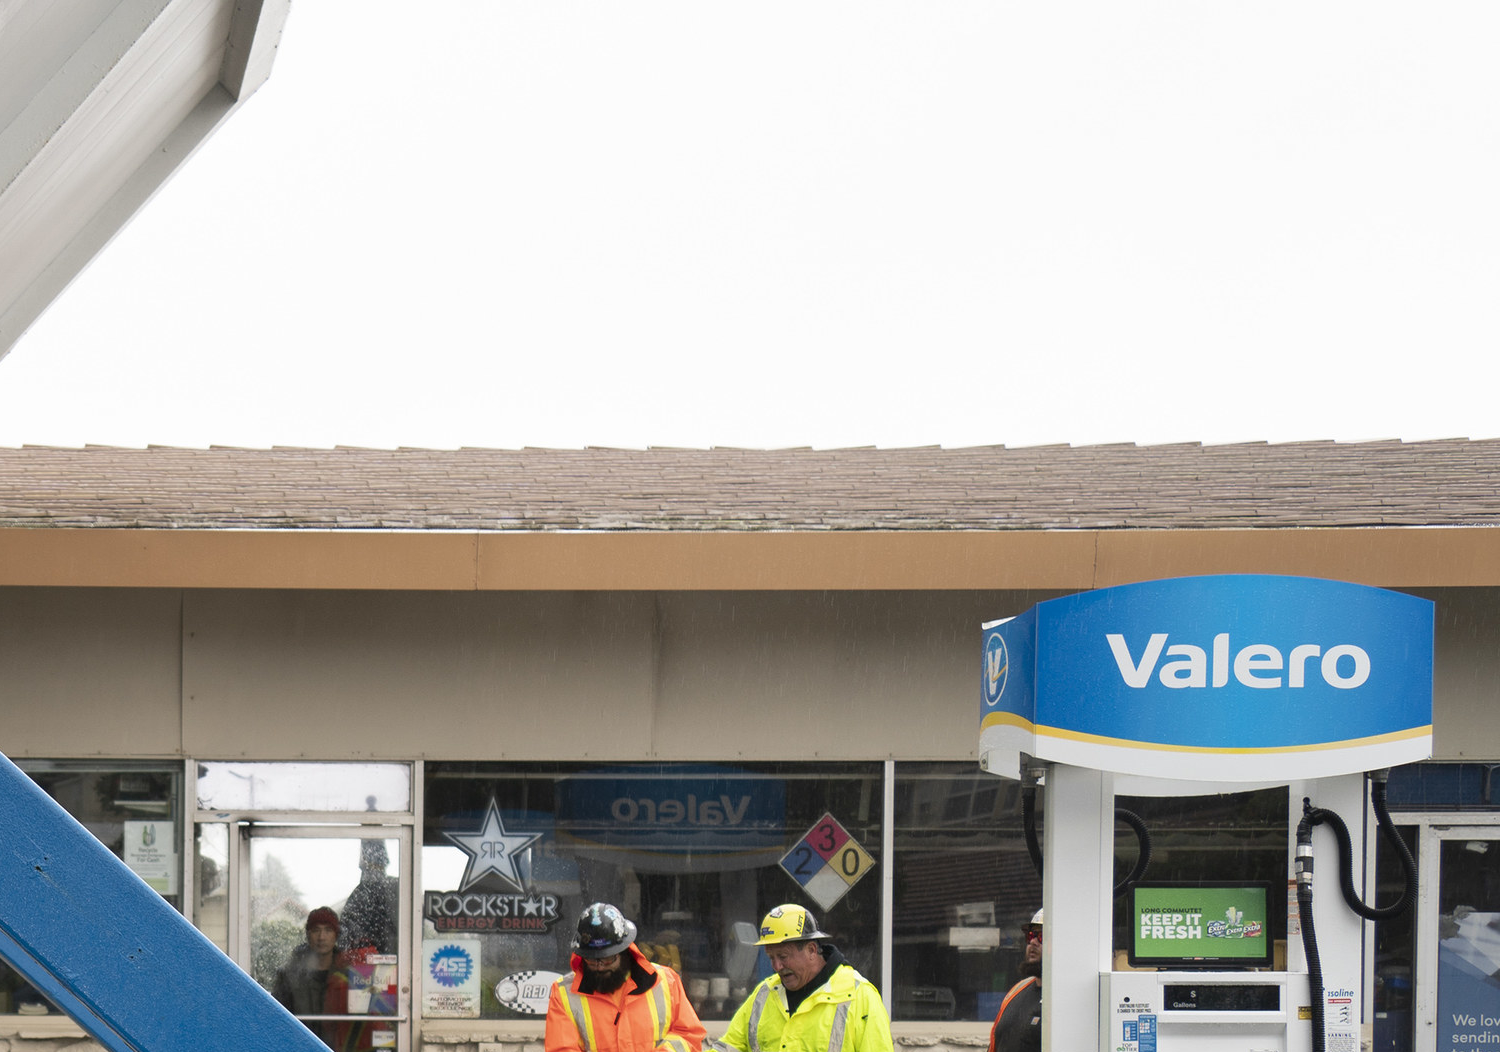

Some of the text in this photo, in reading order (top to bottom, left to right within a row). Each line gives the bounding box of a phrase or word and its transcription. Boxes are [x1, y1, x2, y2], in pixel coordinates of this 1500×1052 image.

[1106, 633, 1370, 689] Valero
[818, 824, 835, 852] 3
[794, 847, 859, 876] 2 0
[438, 917, 545, 929] ENERGY DRINK
[1141, 914, 1202, 925] KEEP IT
[1141, 926, 1202, 939] FRESH
[435, 958, 466, 972] ASE
[353, 975, 391, 985] Red Bull
[1452, 1014, 1477, 1026] We
[1452, 1031, 1500, 1043] sendin
